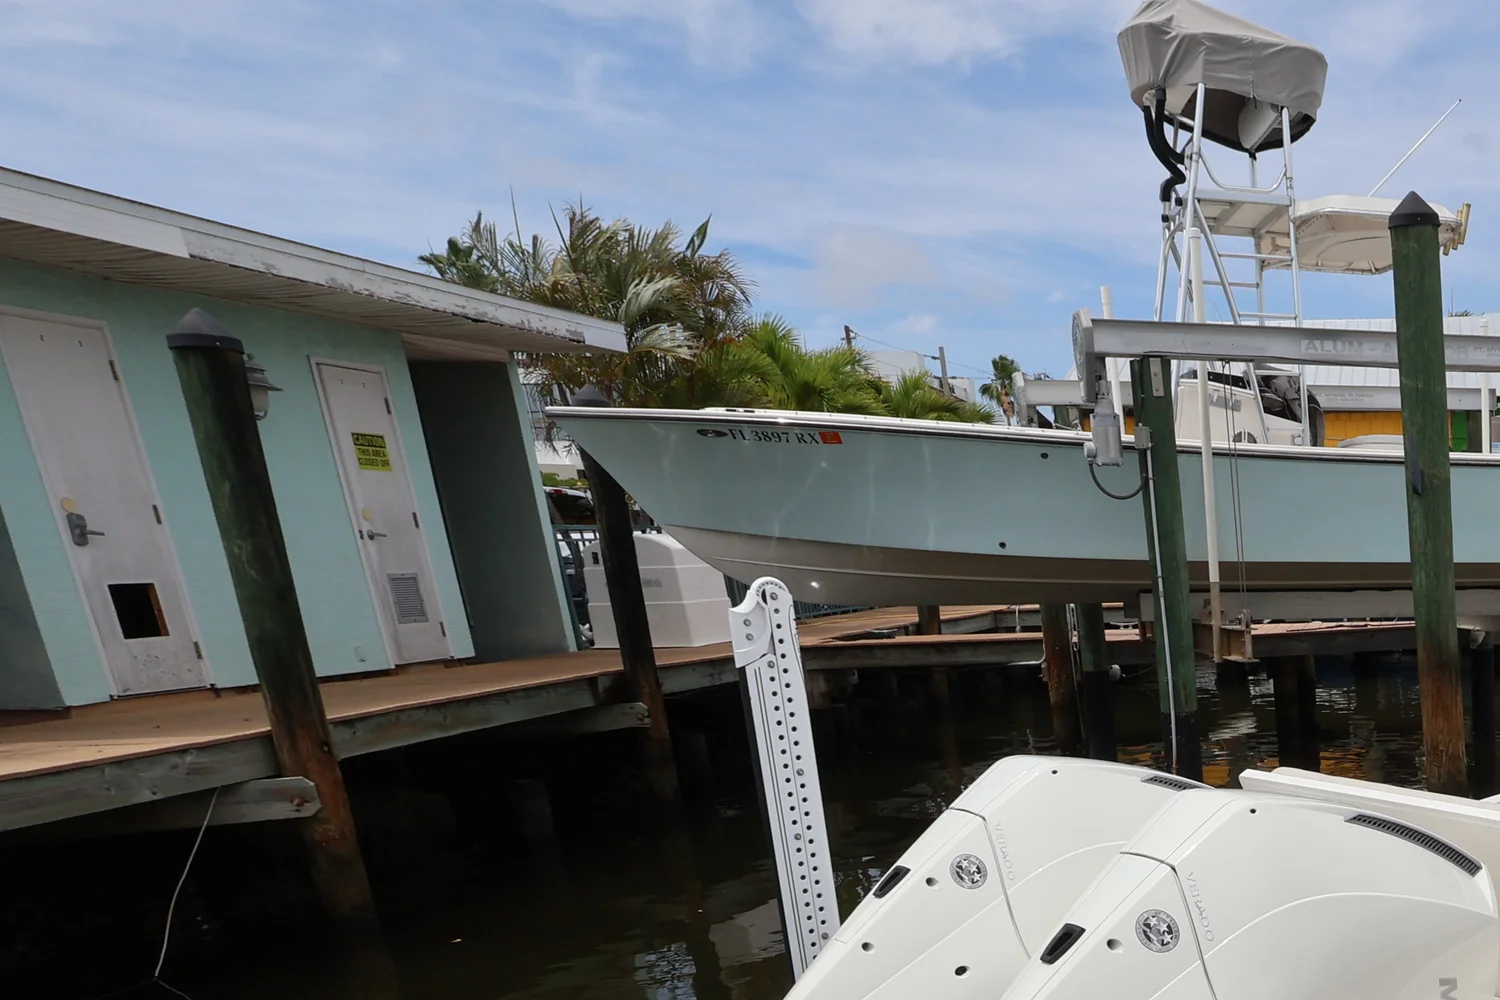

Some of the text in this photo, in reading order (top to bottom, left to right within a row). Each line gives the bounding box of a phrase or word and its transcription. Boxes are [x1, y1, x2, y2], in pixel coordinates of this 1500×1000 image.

[353, 434, 385, 447] CAUTION
[728, 428, 820, 445] FL 3897 RX
[1186, 872, 1215, 942] VERADO
